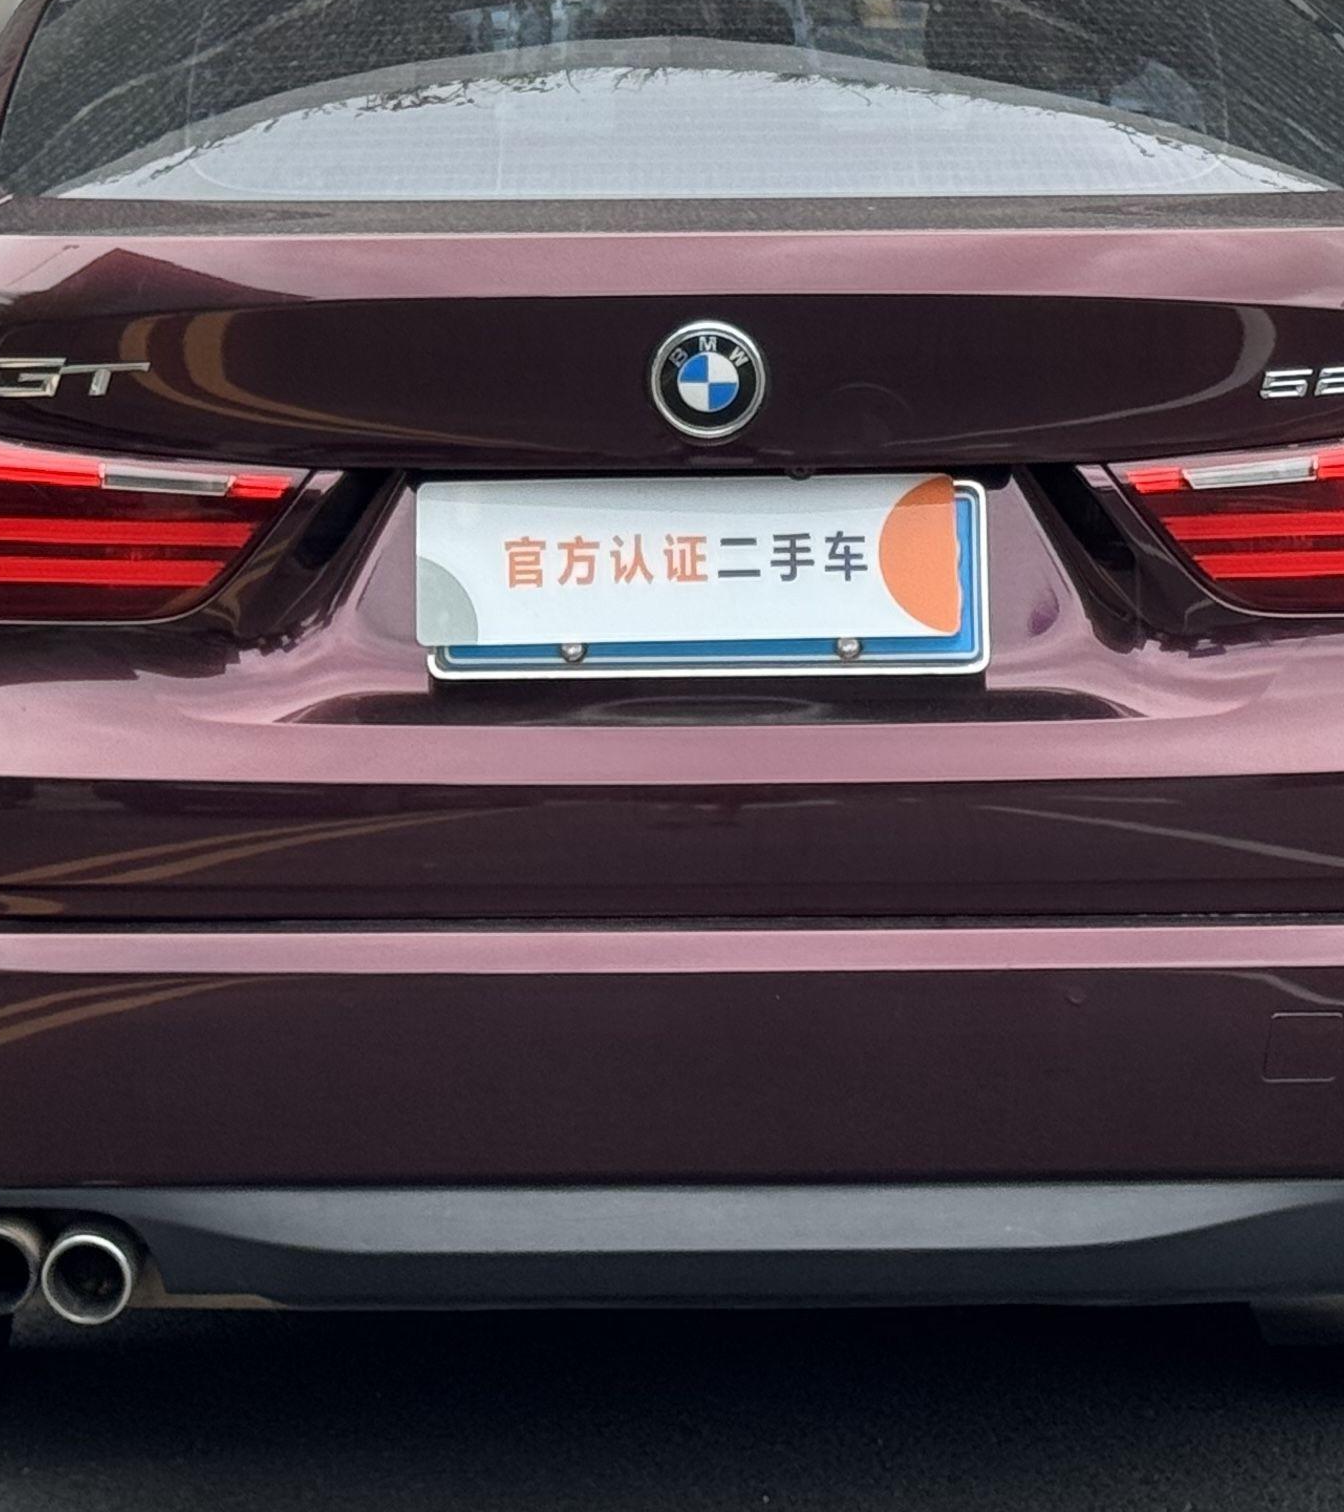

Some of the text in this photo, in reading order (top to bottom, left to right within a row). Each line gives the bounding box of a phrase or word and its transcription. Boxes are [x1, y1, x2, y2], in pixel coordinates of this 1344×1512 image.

[669, 336, 751, 368] BMW
[504, 531, 869, 588] 官方认证二手车
